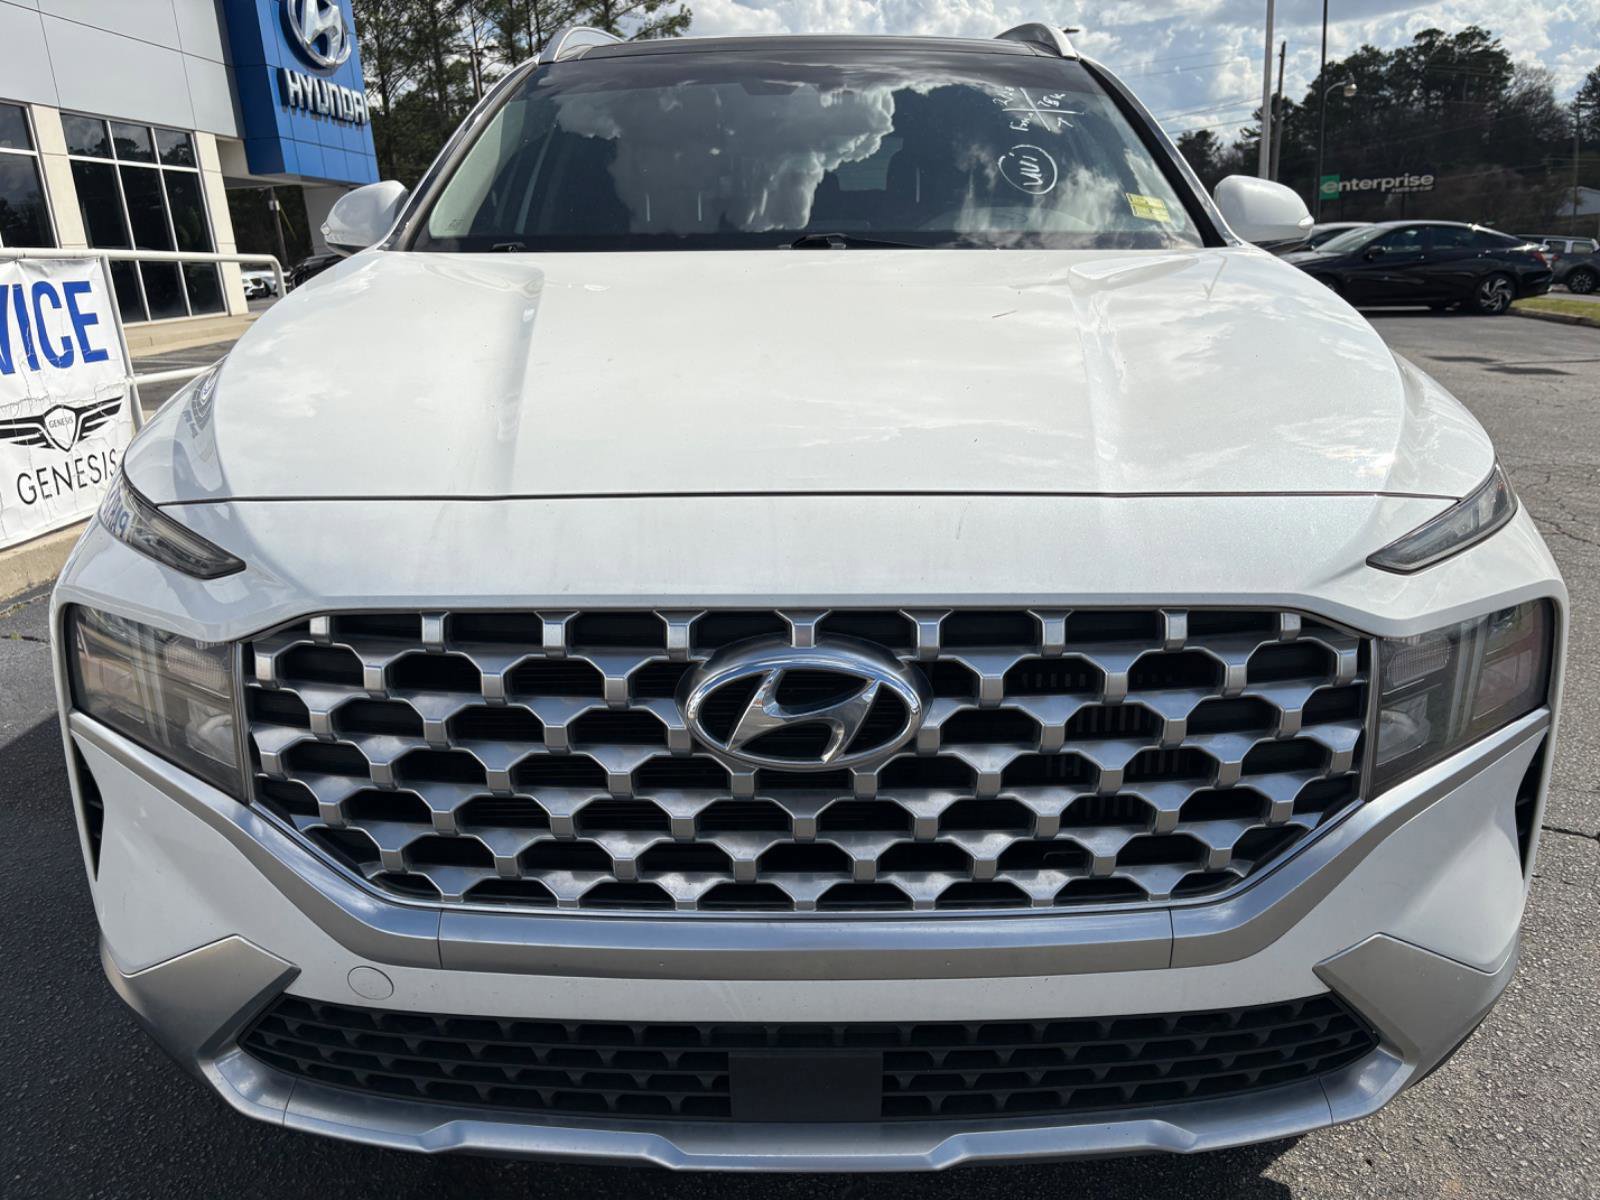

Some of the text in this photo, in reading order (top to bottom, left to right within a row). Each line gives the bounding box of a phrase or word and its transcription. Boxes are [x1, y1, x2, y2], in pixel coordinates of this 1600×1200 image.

[280, 67, 371, 125] HYUNDAI
[1321, 172, 1434, 193] enterprise
[49, 416, 74, 428] GENESIS
[17, 448, 117, 505] GENESIS
